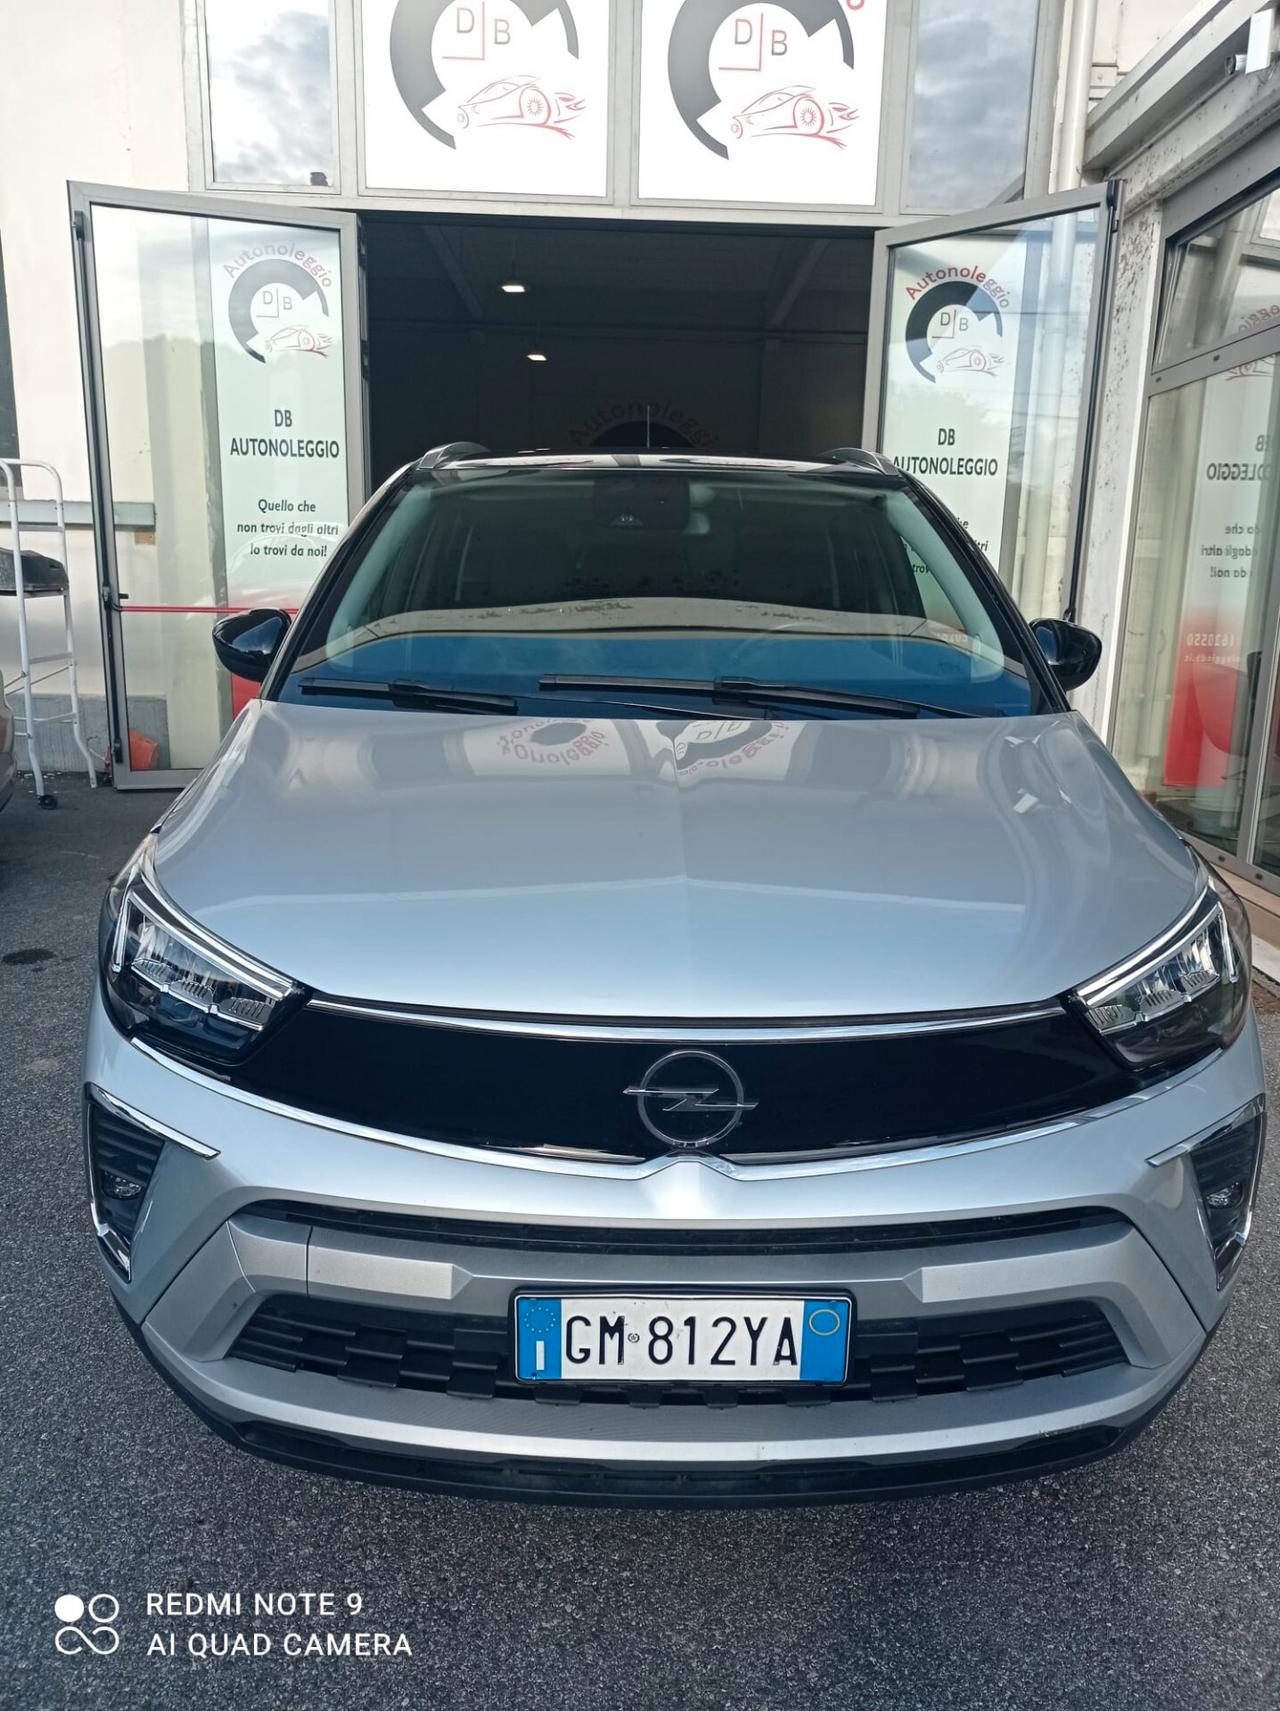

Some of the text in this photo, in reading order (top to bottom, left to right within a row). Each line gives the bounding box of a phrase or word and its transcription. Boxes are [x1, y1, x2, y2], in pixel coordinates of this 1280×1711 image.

[222, 242, 332, 288] Autonoleggio
[905, 265, 1010, 309] Autonoleggio
[273, 408, 293, 427] DB
[568, 399, 720, 448] Autonoleggi
[937, 428, 956, 446] DB
[229, 437, 340, 458] AUTONOLEGGIO
[893, 456, 998, 476] AUTONOLEGGIO
[257, 498, 317, 514] Quello che
[236, 522, 339, 537] non trovi dagli altri
[250, 543, 328, 557] lo trovi da noi!
[565, 1315, 798, 1367] GM 812YA
